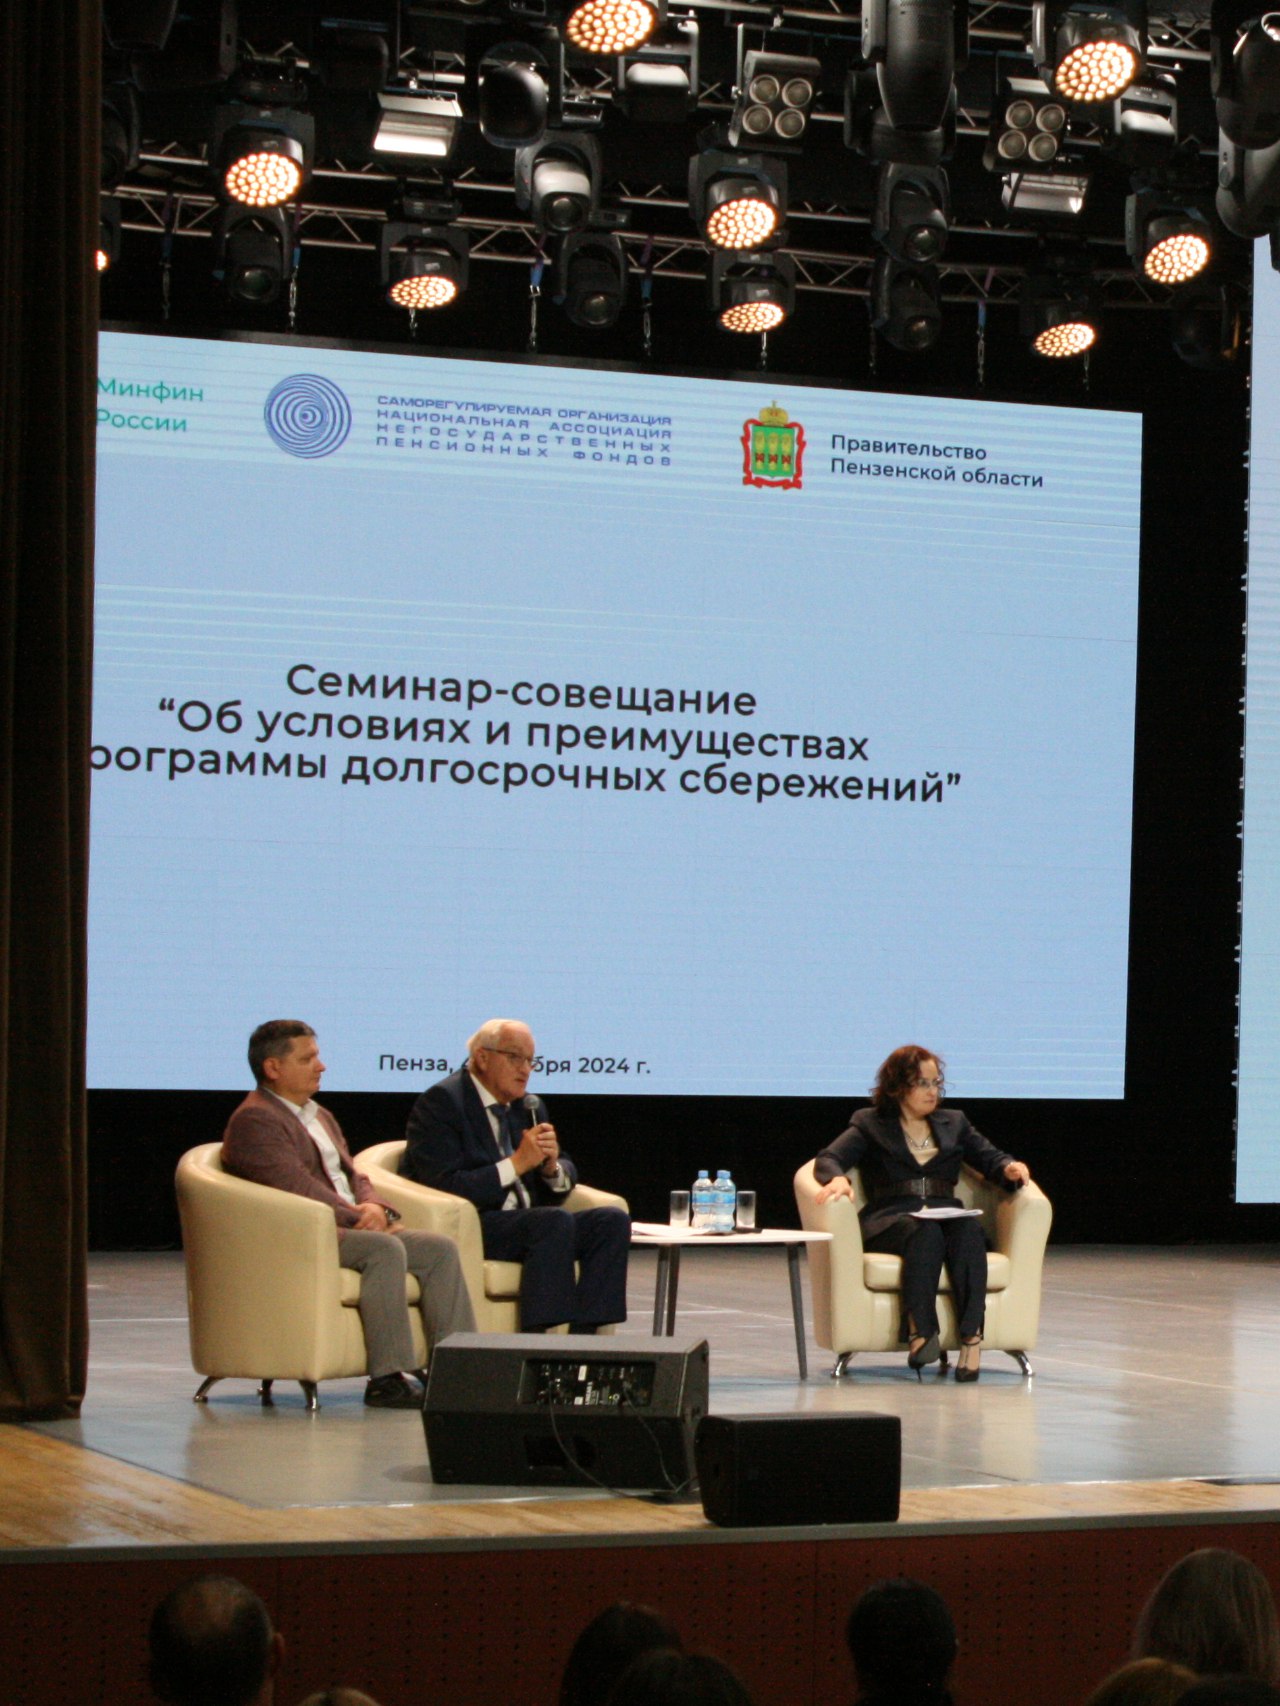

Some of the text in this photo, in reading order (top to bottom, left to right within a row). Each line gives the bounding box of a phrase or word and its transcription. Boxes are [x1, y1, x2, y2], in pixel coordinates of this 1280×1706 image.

[97, 378, 203, 403] Минфин
[96, 408, 187, 432] России
[376, 409, 672, 440] НАЦИОНАЛЬНАЯ АССОЦИАЦИЯ
[377, 395, 672, 426] САМОРЕГУЛИРУЕМАЯ ОРГАНИЗАЦИЯ
[376, 423, 670, 453] НЕГОСУДАРСТВЕННЫХ
[376, 436, 671, 466] ПЕНСИОННЫХ ФОНДОВ
[831, 434, 987, 461] Правительство
[831, 457, 1043, 488] Пензенской области
[286, 663, 757, 716] Семинар-совещание
[158, 698, 869, 761] “Об условиях и преимуществах
[90, 745, 961, 803] рограммы долгосрочных сбережений”
[379, 1054, 453, 1074] Пенза,
[578, 1057, 631, 1074] 2024
[636, 1060, 651, 1074] г.
